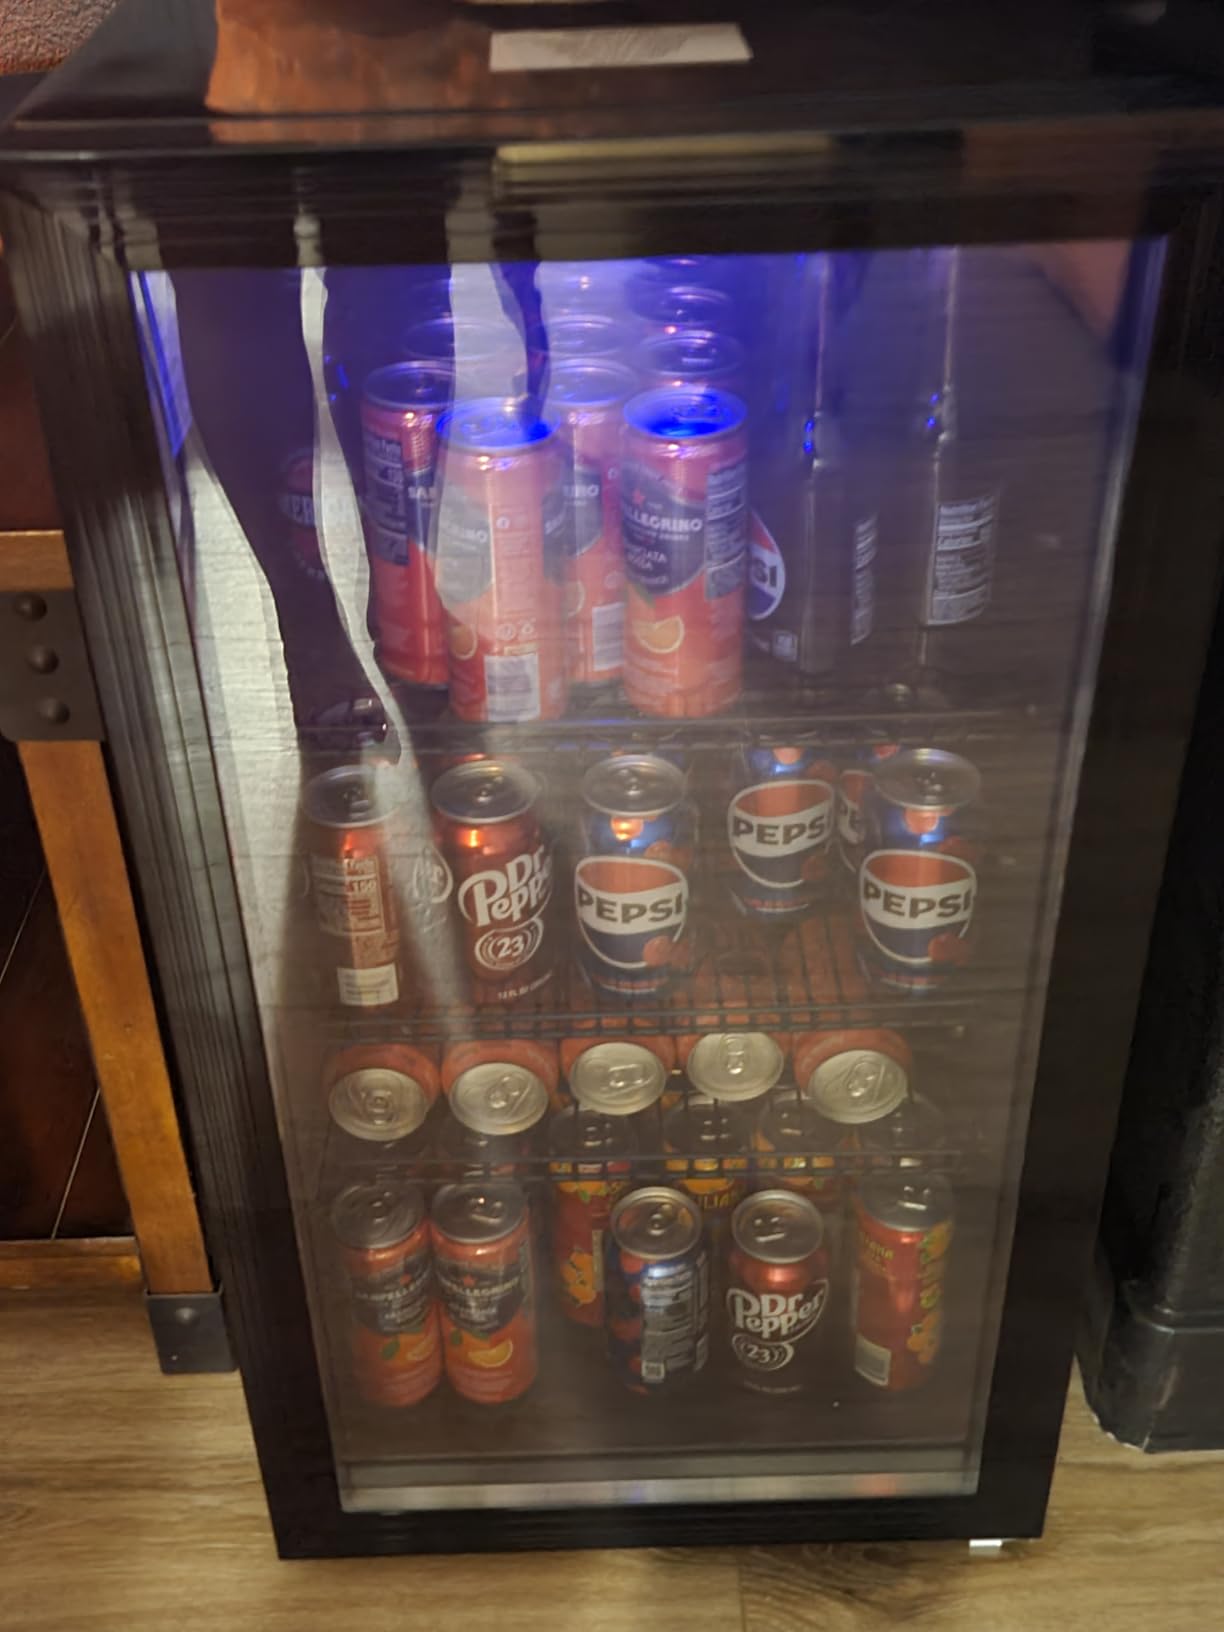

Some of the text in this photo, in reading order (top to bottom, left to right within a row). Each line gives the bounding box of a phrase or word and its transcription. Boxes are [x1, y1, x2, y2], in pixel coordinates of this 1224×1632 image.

[578, 883, 683, 925] PEPSI
[863, 876, 973, 919] PEPSI
[497, 934, 526, 960] 23
[729, 1287, 825, 1340] Pepper
[761, 1293, 804, 1317] Dr
[747, 1344, 771, 1364] 23
